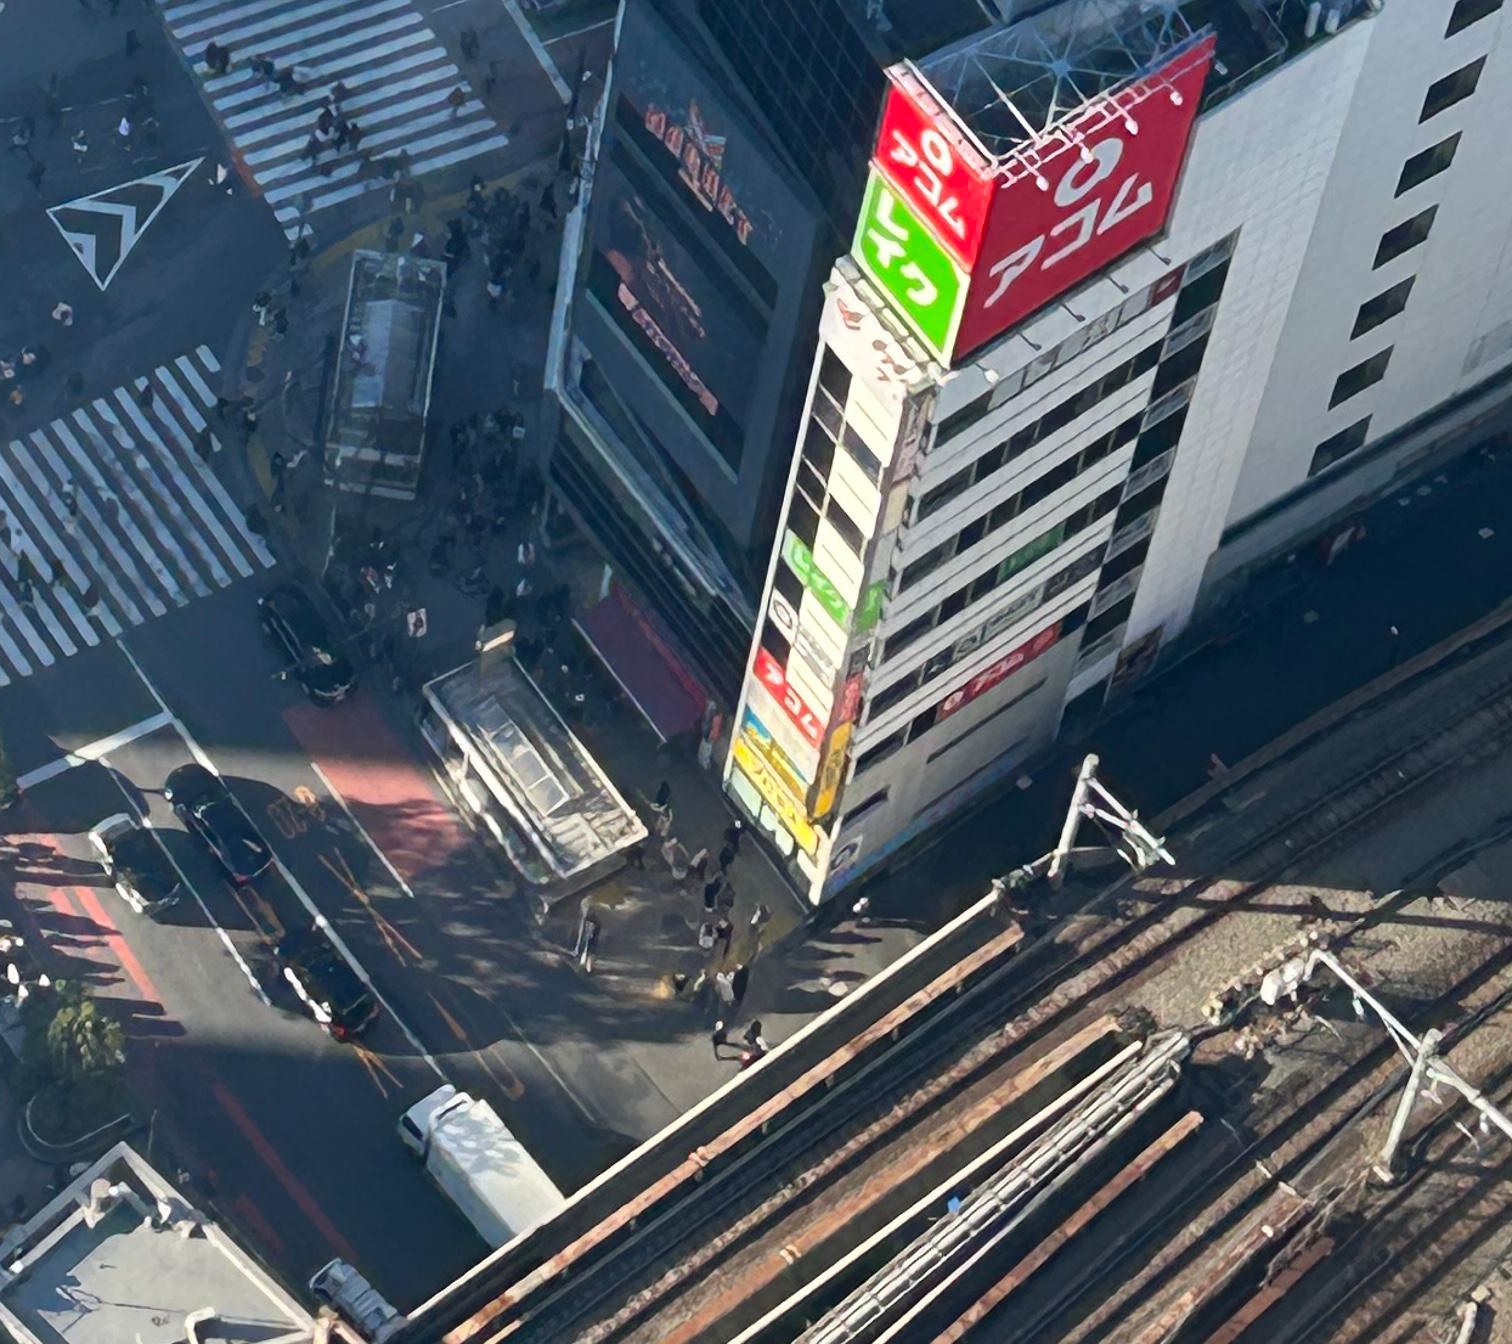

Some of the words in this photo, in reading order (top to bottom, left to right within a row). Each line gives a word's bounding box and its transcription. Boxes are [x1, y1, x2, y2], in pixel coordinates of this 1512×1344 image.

[888, 130, 967, 240] アコム
[983, 172, 1154, 310] アコム
[866, 188, 939, 308] レイク
[763, 662, 821, 742] アコム
